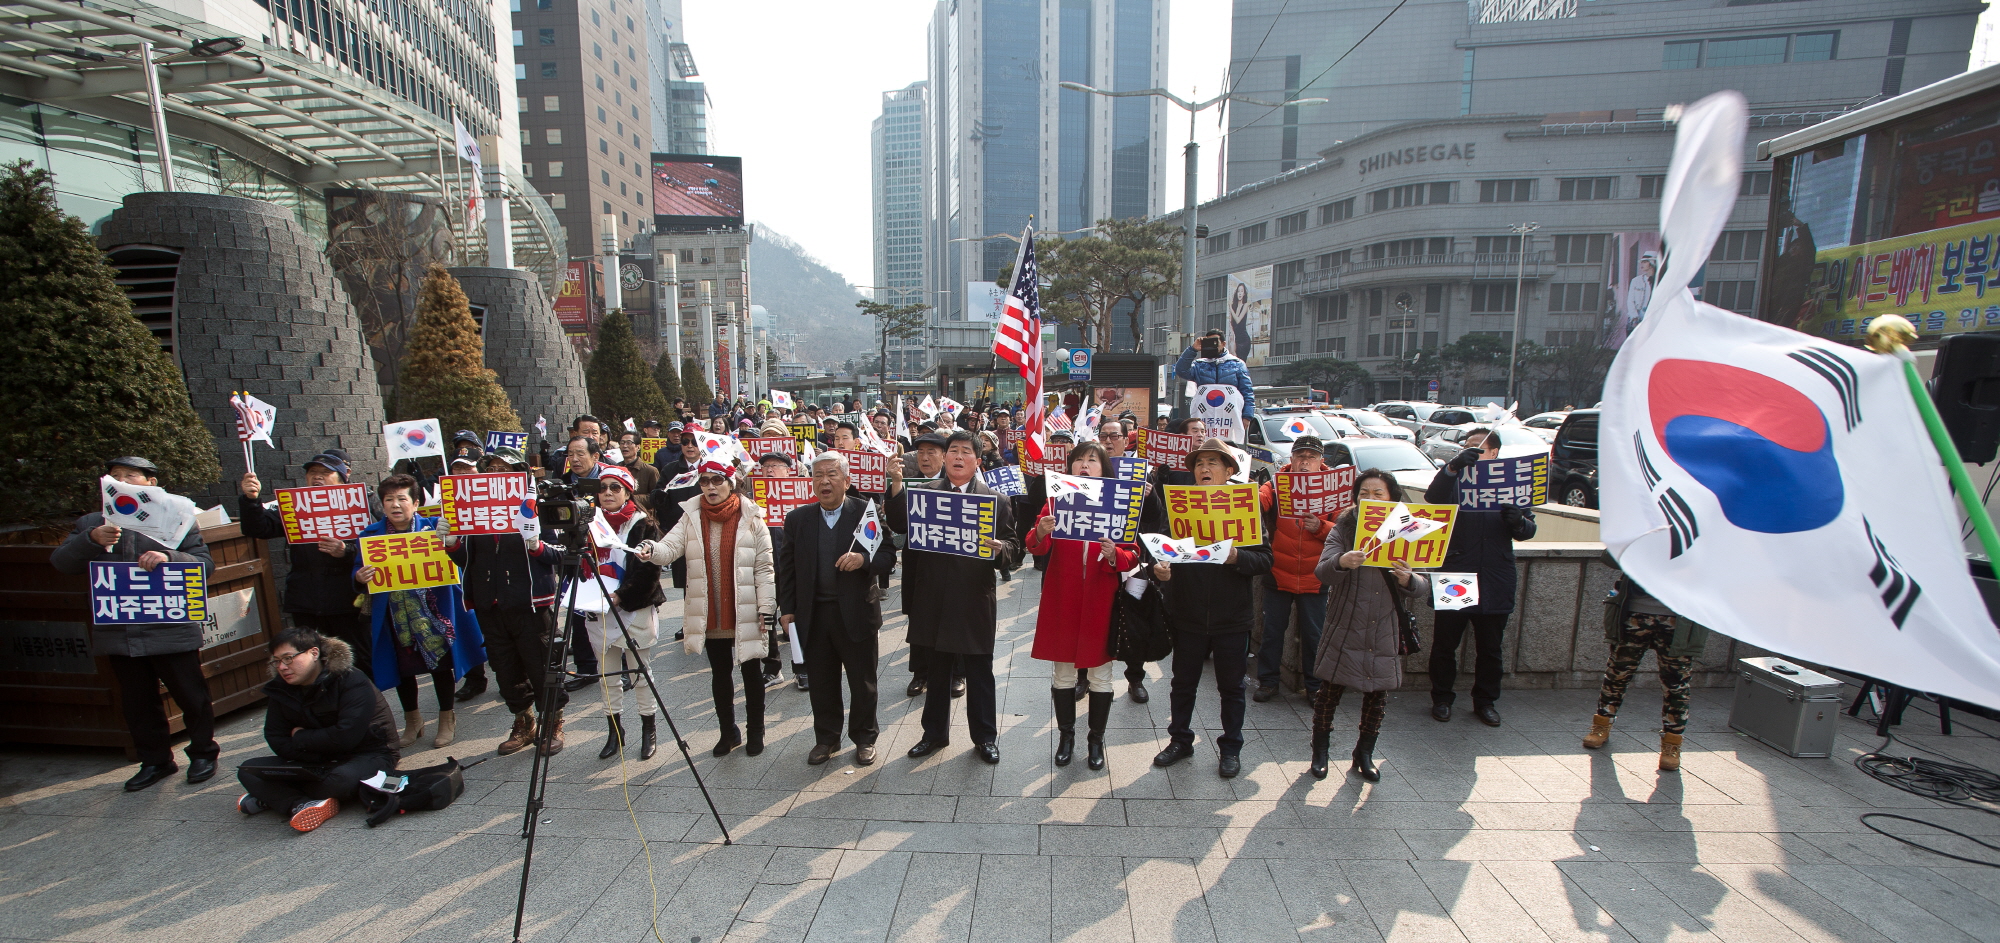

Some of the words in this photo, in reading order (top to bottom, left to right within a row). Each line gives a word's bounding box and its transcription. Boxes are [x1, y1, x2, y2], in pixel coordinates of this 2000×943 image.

[1359, 142, 1476, 175] SHINSEGAE
[1847, 242, 1937, 311] 사드배치
[1146, 431, 1191, 453] 사드배치
[455, 475, 527, 503] 사드배치
[848, 473, 885, 491] 복중단
[1290, 468, 1354, 495] 사드배치
[1532, 456, 1547, 505] THAAD
[295, 486, 367, 514] 사드배치
[440, 478, 459, 532] THAAD
[1169, 488, 1255, 515] 중국속국
[1276, 474, 1293, 516] THAAD
[1293, 490, 1353, 517] 보복중단
[1460, 484, 1532, 508] 자주국방
[278, 491, 303, 542] THAAD
[299, 513, 373, 539] 보복중단
[1054, 509, 1127, 540] 자주국방
[1123, 485, 1144, 542] THAAD
[909, 522, 979, 553] 자주국방
[978, 500, 995, 558] THAAD
[1173, 517, 1257, 543] 아니다!
[372, 559, 456, 588] 아니다!
[184, 565, 206, 621] THAAD
[96, 595, 187, 620] 자주국방
[13, 635, 89, 659] 서울중앙우체국
[214, 630, 237, 642] Tower
